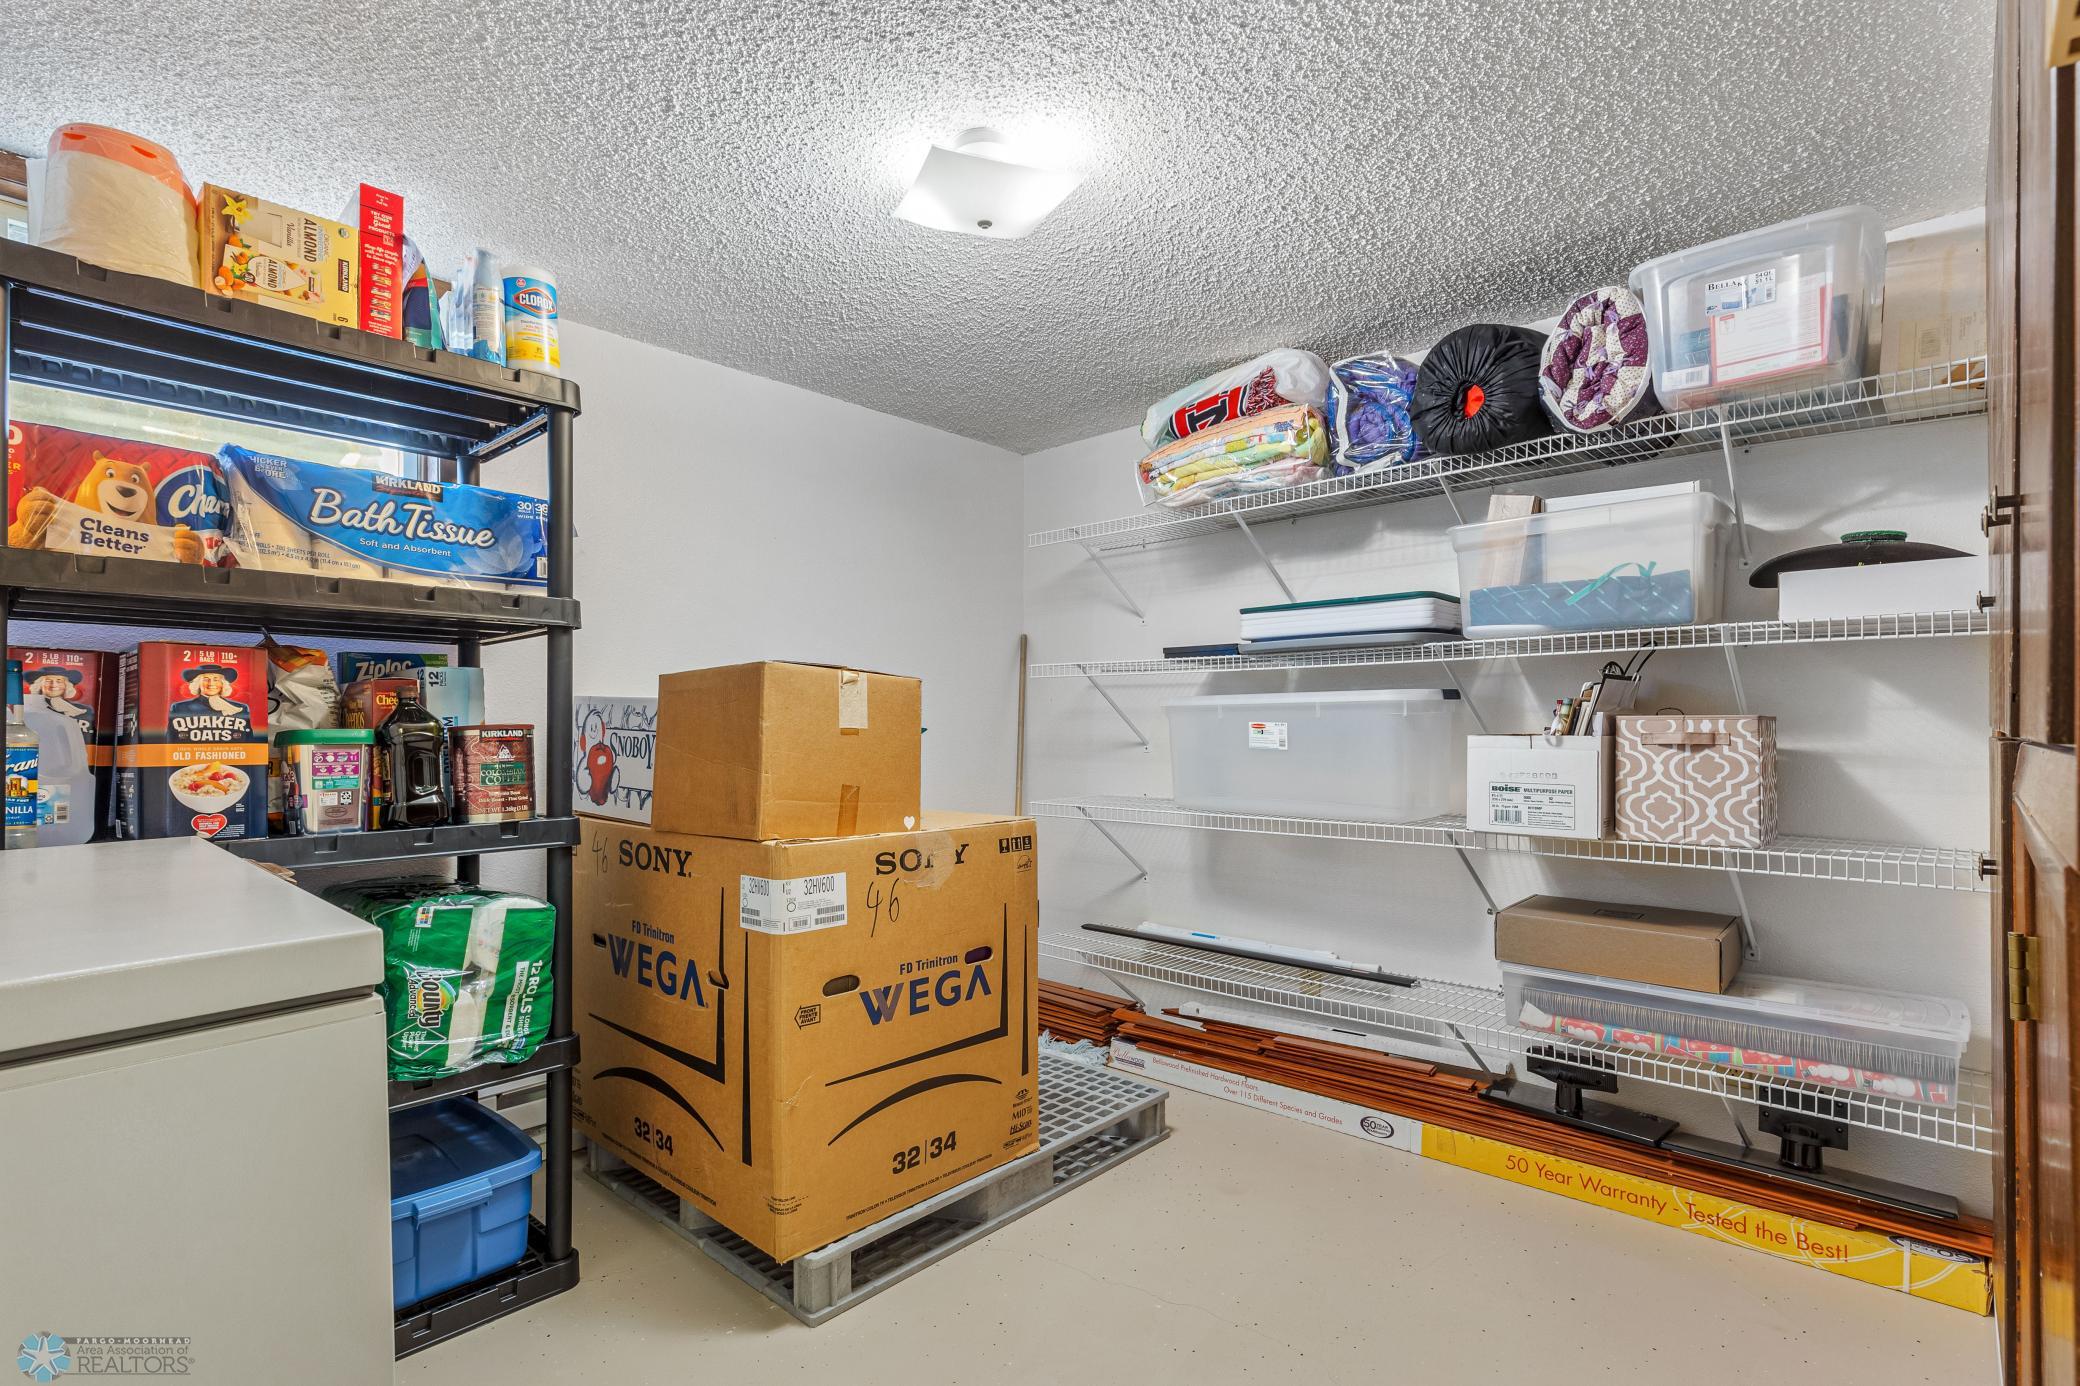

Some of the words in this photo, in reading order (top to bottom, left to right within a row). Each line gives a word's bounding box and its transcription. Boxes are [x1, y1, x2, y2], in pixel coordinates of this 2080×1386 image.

[286, 222, 295, 247] Vanilla
[304, 218, 317, 262] ALMOND
[268, 260, 278, 288] ALMOND
[520, 293, 554, 311] CLOROX
[376, 475, 442, 495] KIRKLAND
[517, 500, 532, 511] 30
[310, 487, 404, 535] Bath
[402, 502, 496, 548] Tissue
[80, 518, 149, 543] Cleans
[80, 532, 144, 555] Better
[360, 537, 379, 549] Soft
[382, 542, 400, 551] and
[403, 544, 451, 557] Absorbent
[25, 652, 33, 663] 2
[66, 654, 84, 662] 110+
[183, 650, 191, 662] 2
[221, 652, 238, 660] 110+
[356, 658, 412, 680] Ziploc
[428, 671, 439, 687] 12
[172, 715, 247, 732] QUAKER
[481, 730, 523, 738] KIRKLAND
[189, 729, 232, 741] OATS
[172, 751, 191, 761] OLD
[195, 751, 246, 761] FASHIONED
[610, 732, 656, 769] SNOBOY
[6, 754, 39, 773] rani
[6, 806, 33, 814] NILLA
[619, 839, 692, 878] SONY
[803, 875, 835, 896] 32HV600
[866, 877, 900, 938] 46
[631, 920, 641, 934] FD
[642, 923, 675, 945] Trinitron
[518, 967, 526, 979] THE
[532, 960, 544, 975] 12
[607, 933, 705, 1008] WEGA
[900, 963, 913, 975] FD
[915, 954, 958, 972] Trinitron
[408, 979, 418, 1019] Advanced
[418, 972, 441, 1028] Bounty
[520, 976, 540, 1014] ROLLS
[859, 964, 992, 1026] WEGA
[799, 1011, 818, 1020] FRENTE
[800, 1006, 817, 1015] FRONT
[800, 1016, 817, 1025] AVANT
[1152, 1056, 1180, 1070] Bellawood
[1180, 1064, 1209, 1078] Prefinished
[1210, 1072, 1241, 1086] Hardwood
[1241, 1079, 1259, 1091] Floors
[1223, 1086, 1238, 1096] Over
[1240, 1089, 1252, 1099] 115
[1253, 1094, 1278, 1107] Different
[1279, 1101, 1303, 1115] Species
[1304, 1108, 1317, 1119] and
[1318, 1112, 1343, 1126] Grades
[1363, 1119, 1377, 1130] 50
[1505, 1154, 1529, 1174] 50
[1535, 1160, 1573, 1186] Year
[1578, 1173, 1667, 1216] Warranty
[1684, 1201, 1747, 1235] Tested
[1755, 1220, 1788, 1245] the
[1796, 1231, 1849, 1263] Best!
